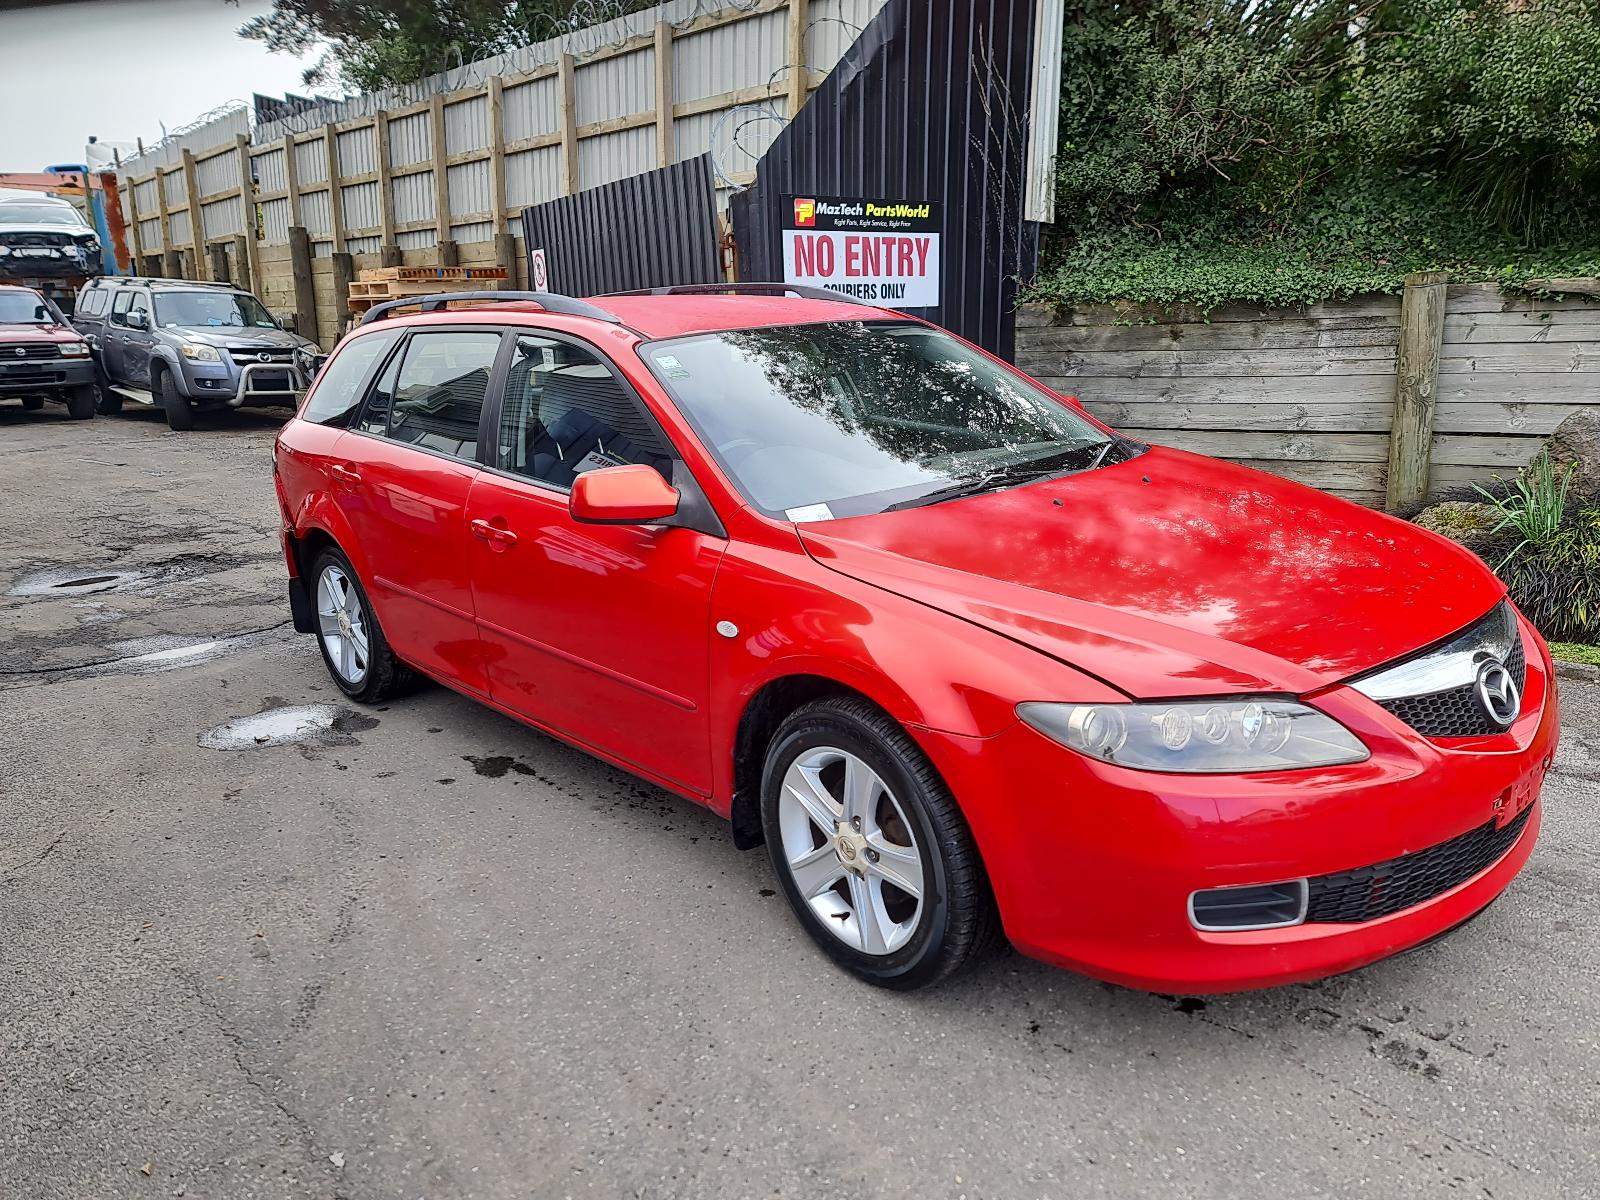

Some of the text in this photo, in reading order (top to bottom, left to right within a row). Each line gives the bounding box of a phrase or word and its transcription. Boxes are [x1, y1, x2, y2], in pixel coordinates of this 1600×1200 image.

[816, 202, 863, 216] MazTech
[866, 203, 930, 218] PartsWorld
[793, 234, 930, 278] NO ENTRY
[880, 283, 906, 299] ONLY
